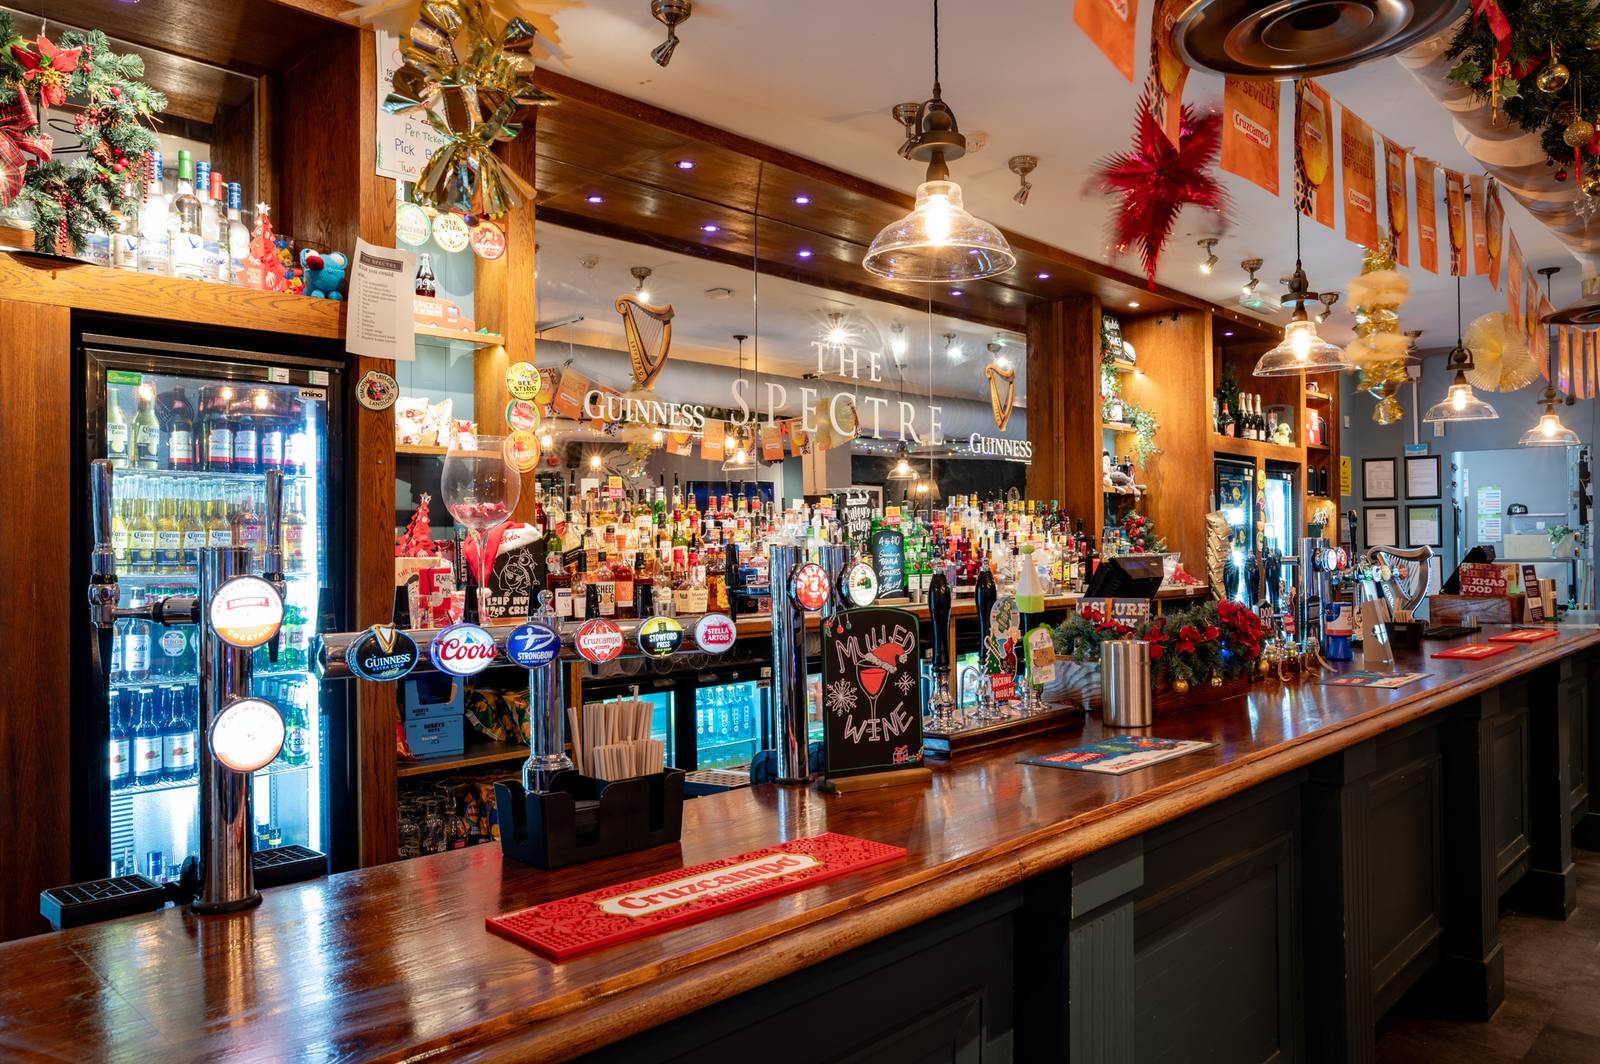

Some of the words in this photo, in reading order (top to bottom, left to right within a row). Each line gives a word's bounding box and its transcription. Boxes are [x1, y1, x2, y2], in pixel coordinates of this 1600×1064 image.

[1243, 81, 1276, 113] SEVILLA
[405, 123, 419, 137] Per
[1235, 113, 1269, 143] Cruzcampo
[394, 138, 415, 156] Pick
[811, 341, 882, 383] THE
[301, 390, 324, 399] rhino
[584, 389, 705, 429] GUINNESS
[731, 378, 943, 446] SPECTRE
[970, 432, 1032, 458] GUINNESS
[1461, 585, 1493, 594] FOOD
[1471, 577, 1505, 587] XMAS
[226, 622, 273, 642] COCKTAIL
[582, 634, 621, 645] Cruzcampo
[649, 631, 678, 643] STOWFORD
[707, 627, 730, 636] STELLA
[707, 634, 730, 642] ARTOIS
[437, 639, 497, 662] Coors
[517, 652, 553, 661] STRONGBOW
[364, 653, 412, 670] GUINNESS
[844, 700, 914, 745] WINE
[617, 857, 801, 911] Cruzcampo
